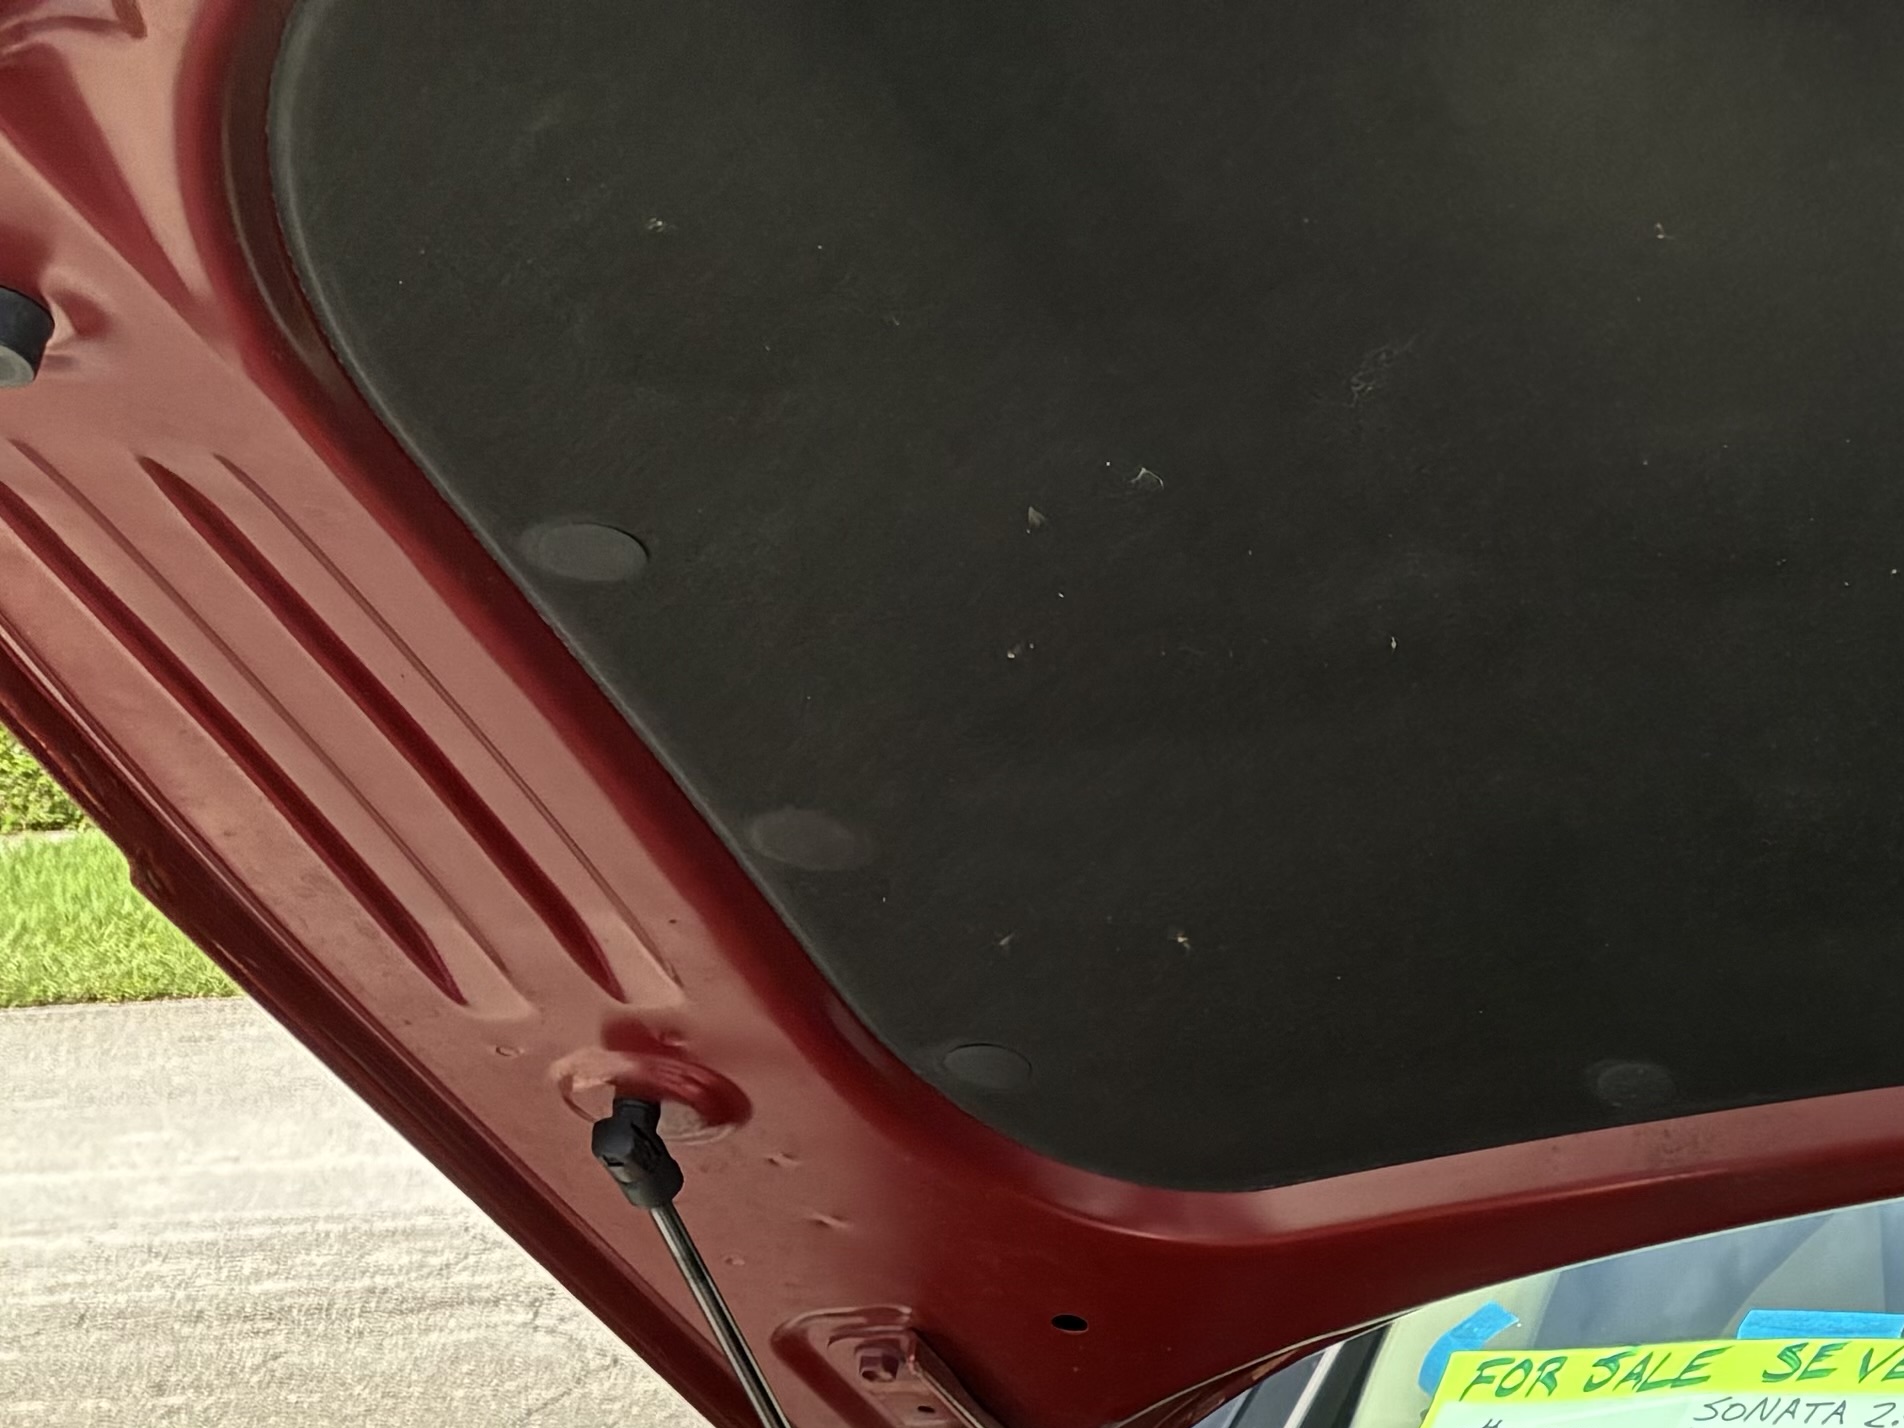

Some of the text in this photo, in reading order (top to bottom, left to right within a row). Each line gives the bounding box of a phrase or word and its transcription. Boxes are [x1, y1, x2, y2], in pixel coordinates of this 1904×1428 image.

[1459, 1356, 1568, 1401] FOR
[1583, 1345, 1734, 1392] SALE
[1692, 1396, 1846, 1425] SONATA
